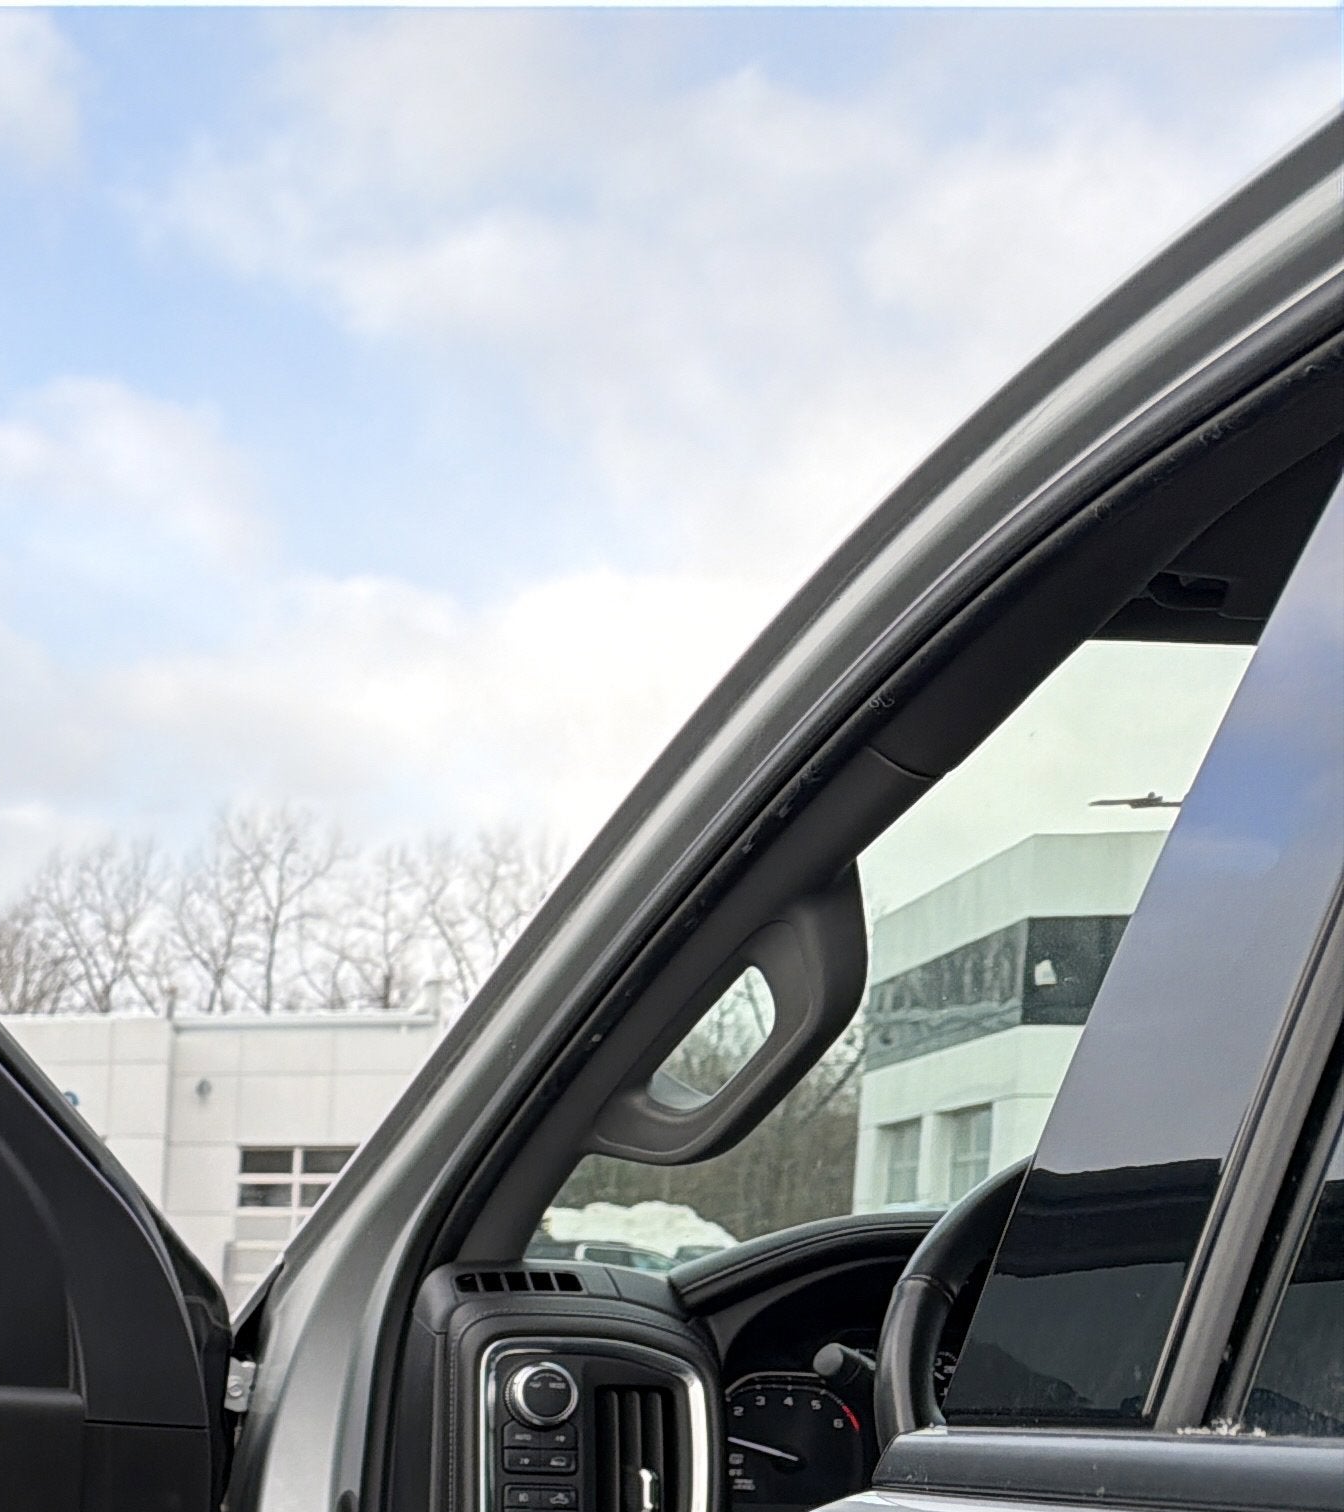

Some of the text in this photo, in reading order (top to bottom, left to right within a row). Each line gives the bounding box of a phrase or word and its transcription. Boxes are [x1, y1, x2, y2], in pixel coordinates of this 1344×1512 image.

[733, 1406, 744, 1416] 2
[755, 1396, 766, 1406] 3
[783, 1396, 794, 1406] 4
